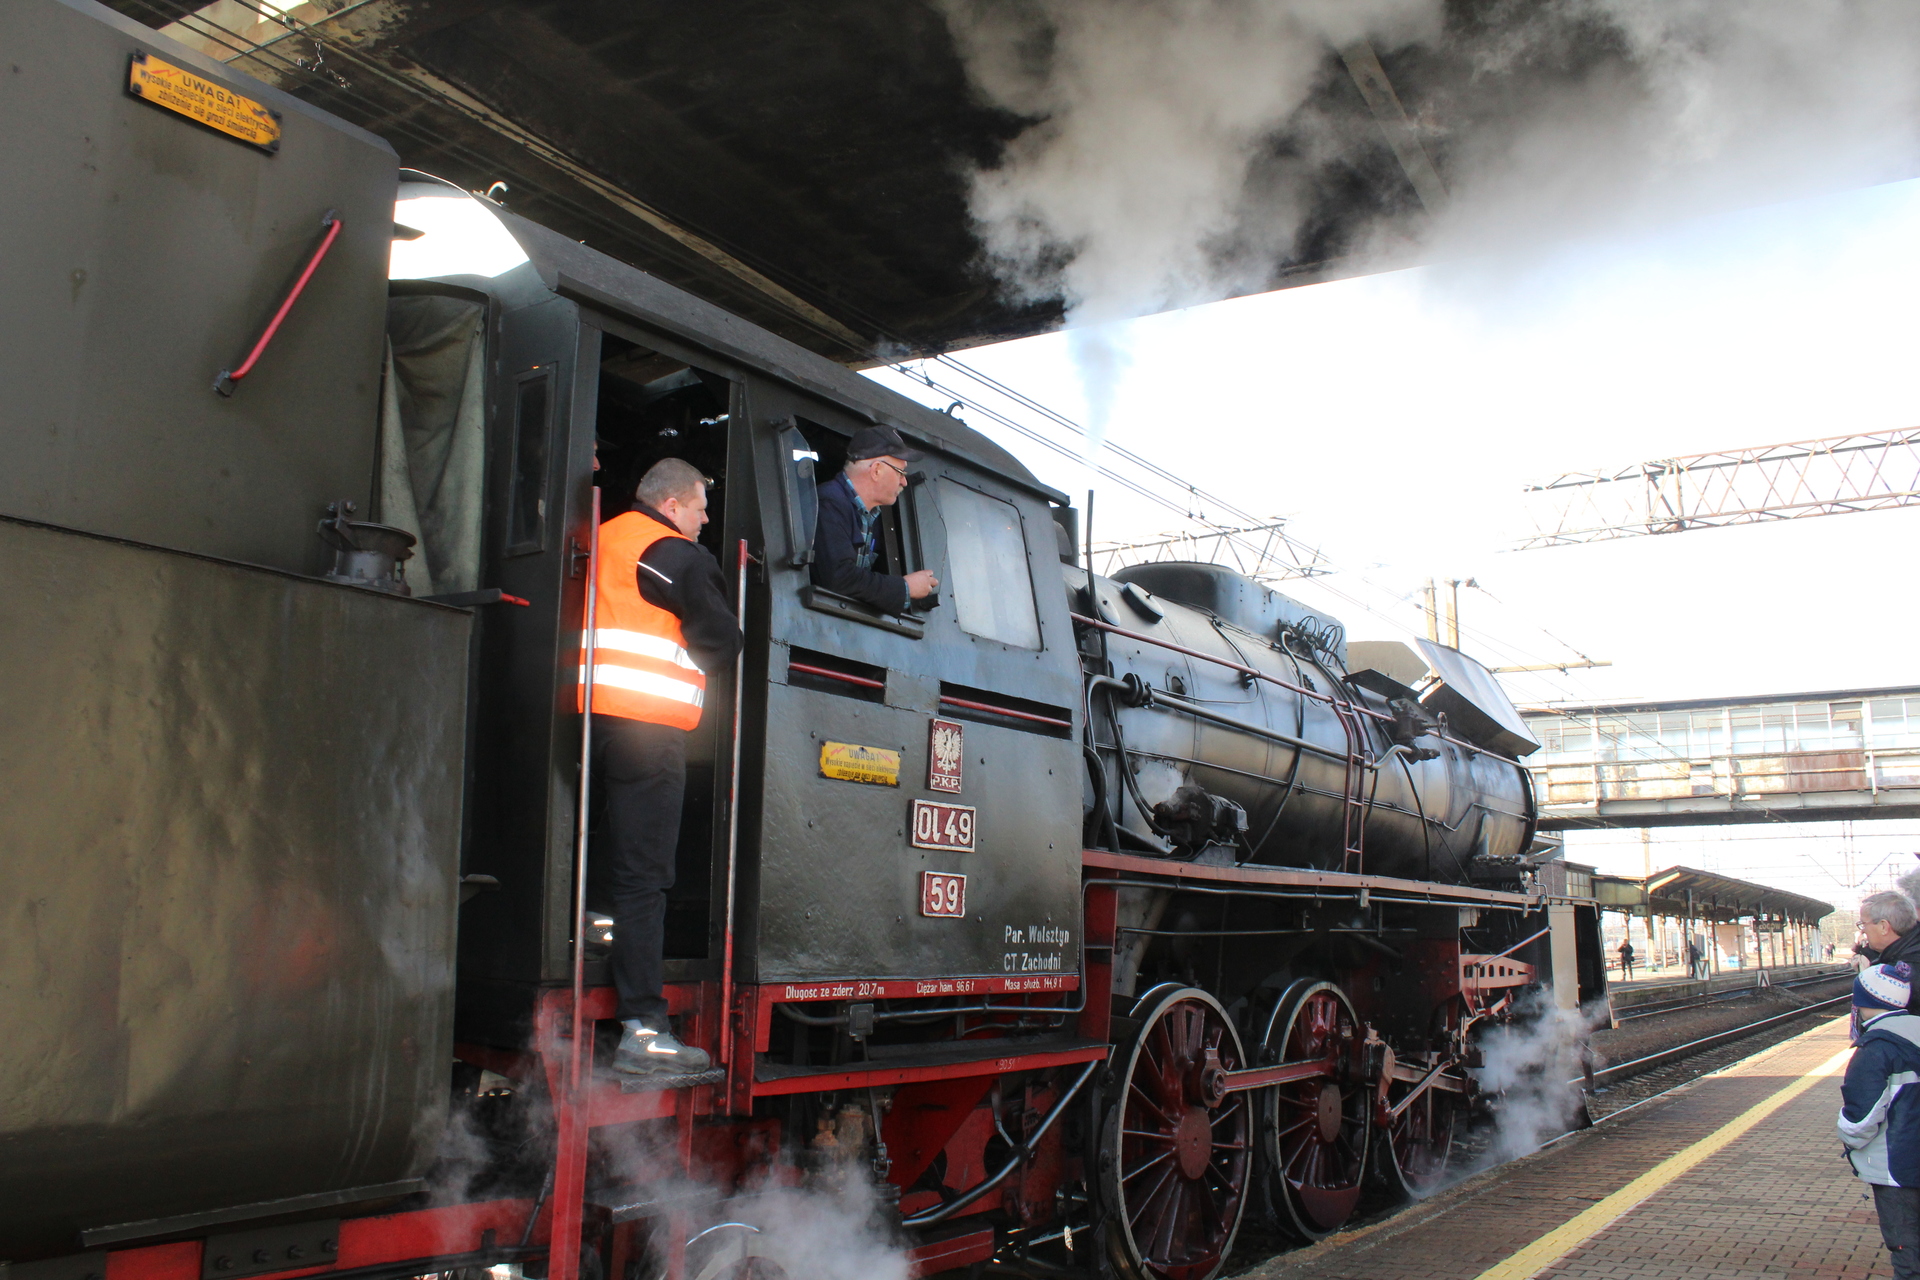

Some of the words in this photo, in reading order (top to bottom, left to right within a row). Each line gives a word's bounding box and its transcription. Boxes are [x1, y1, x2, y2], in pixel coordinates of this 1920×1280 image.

[182, 75, 241, 109] UWAGA!
[216, 101, 234, 116] sieci
[206, 111, 226, 125] grozi
[930, 876, 959, 913] 59
[1004, 925, 1025, 943] Par.
[1028, 925, 1070, 947] Wolsztyn
[1003, 952, 1018, 971] CT
[1021, 952, 1061, 971] Zachodni
[820, 987, 830, 997] ze
[1004, 978, 1021, 990] Masa
